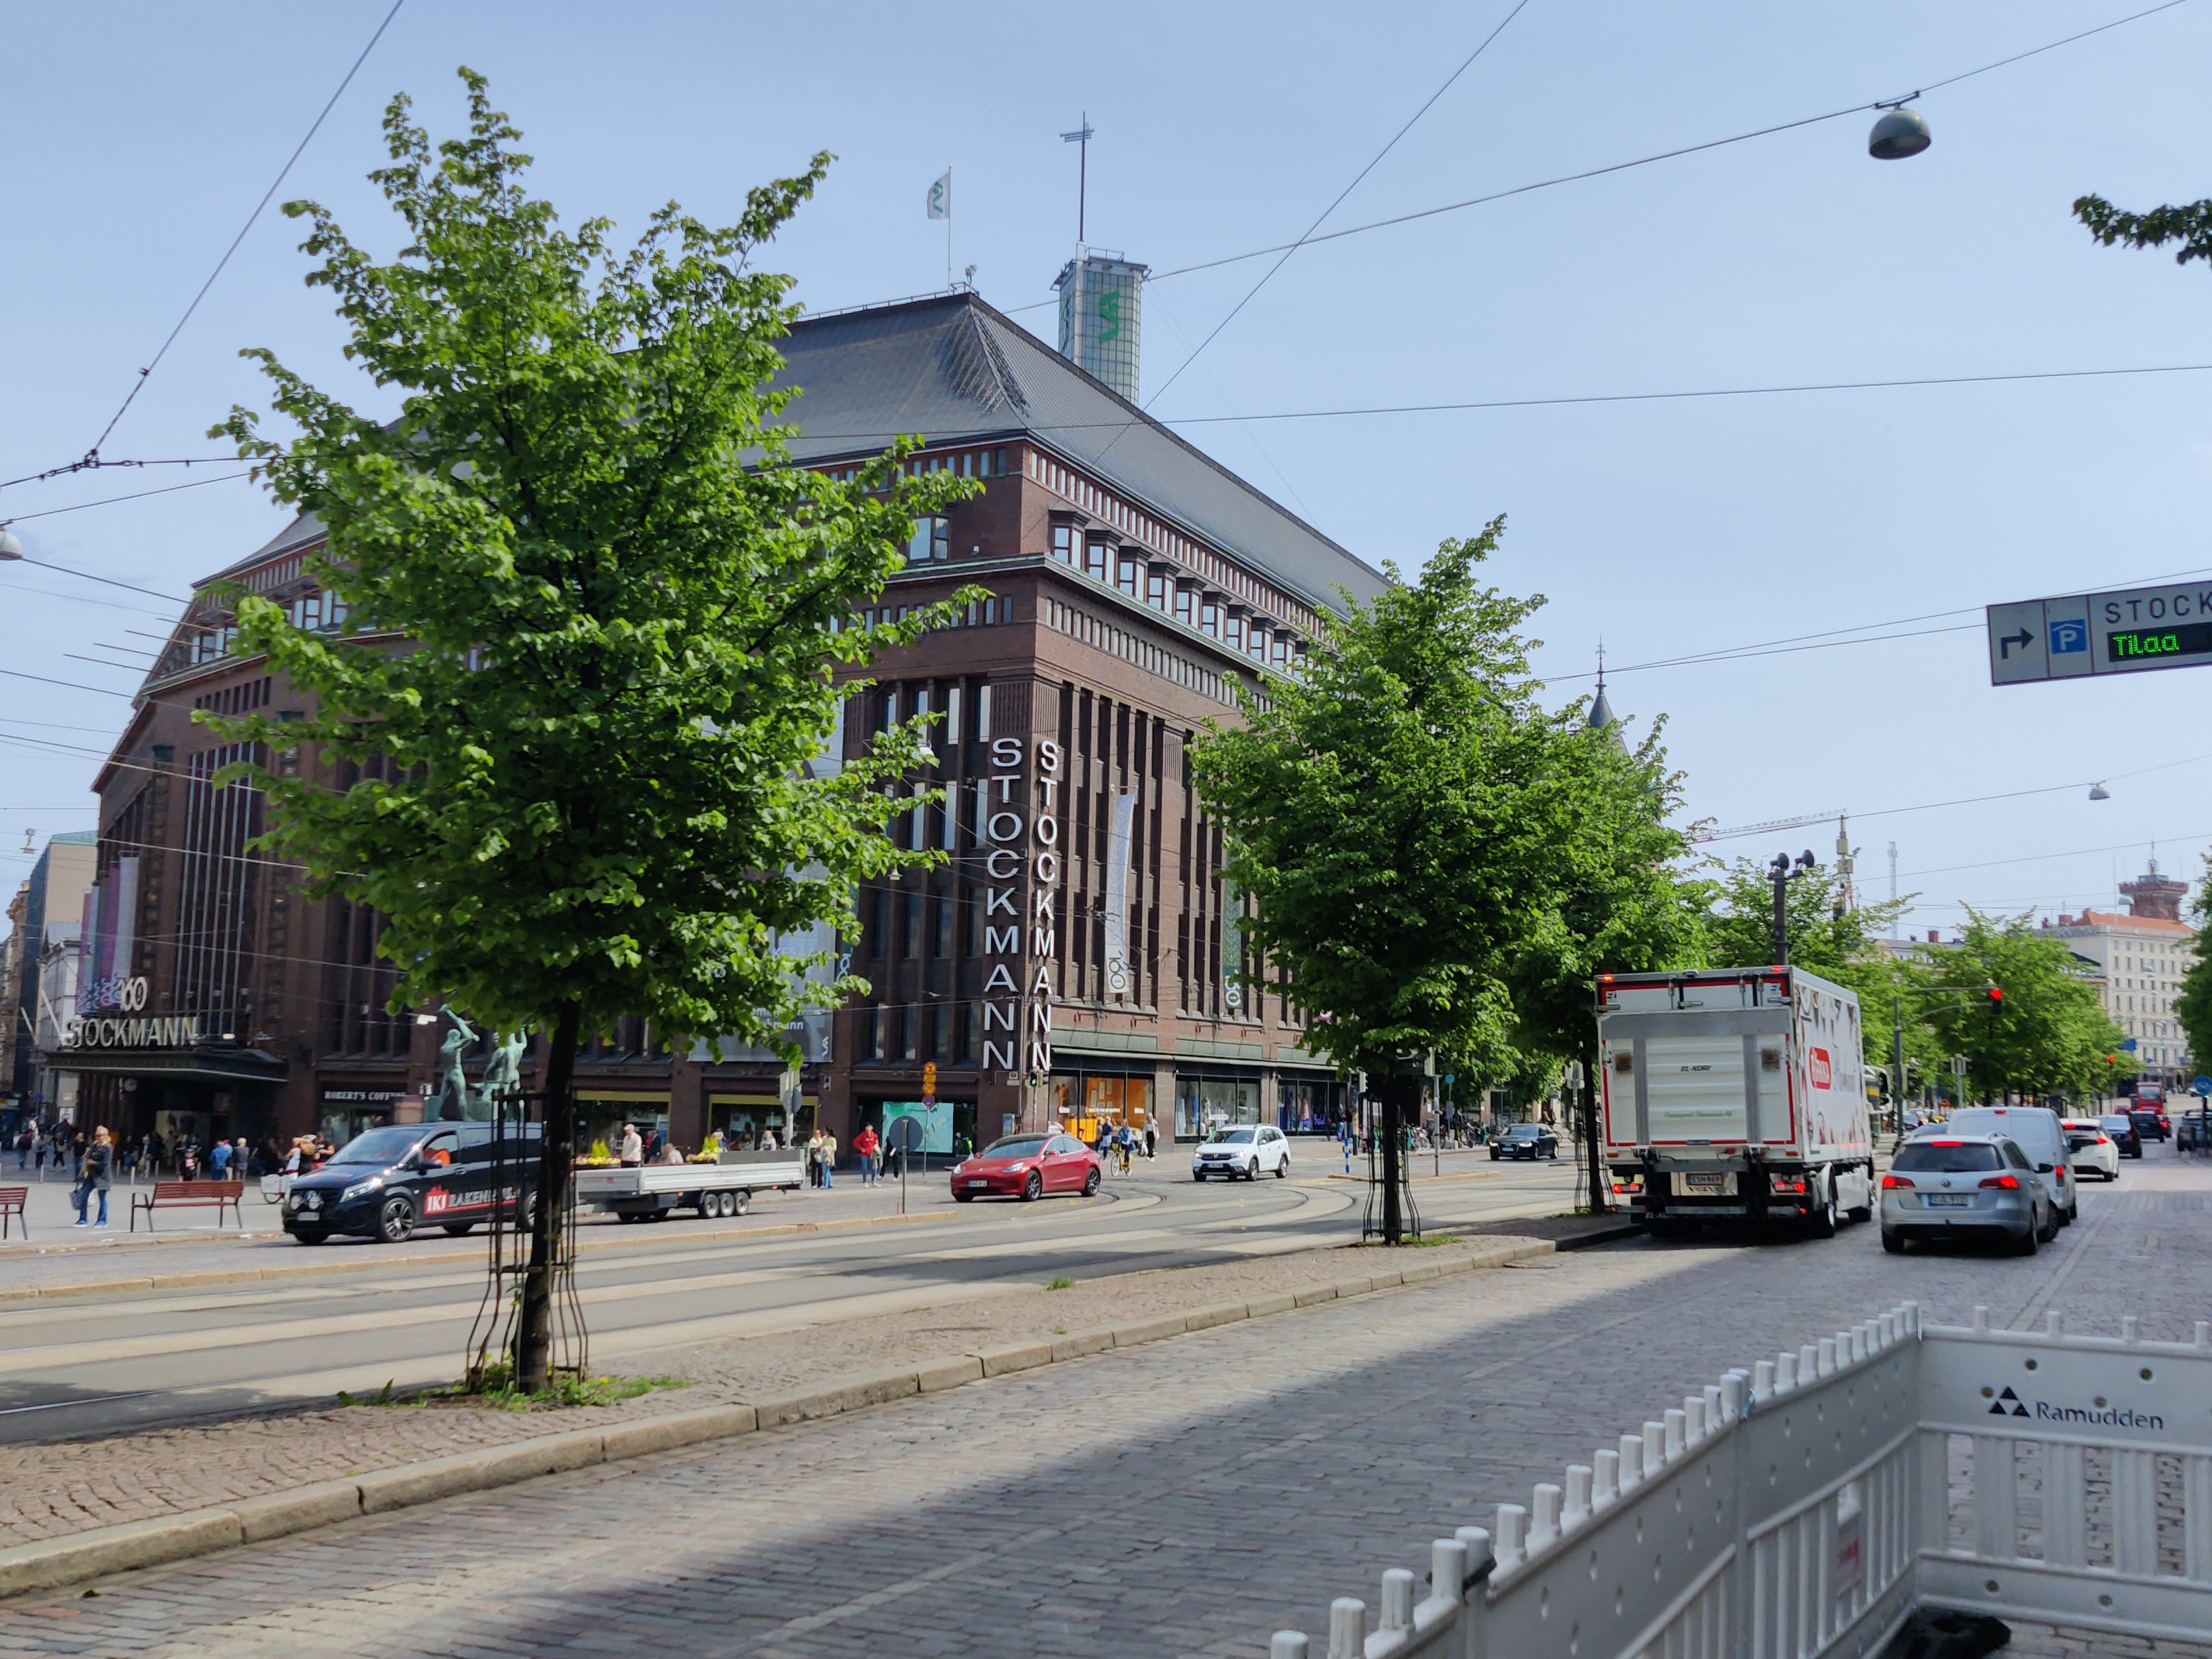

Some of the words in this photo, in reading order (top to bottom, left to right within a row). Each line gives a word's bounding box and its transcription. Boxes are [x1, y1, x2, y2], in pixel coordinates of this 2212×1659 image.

[2060, 629, 2077, 651] P
[2113, 633, 2180, 658] Tilaa
[982, 738, 1024, 1070] STOCKMANN
[1032, 740, 1058, 1071] STOCKMANN
[118, 976, 148, 1011] 160
[65, 1016, 199, 1048] STOCKMANN
[427, 1194, 447, 1212] IKI
[2036, 1401, 2164, 1430] Ramudden
